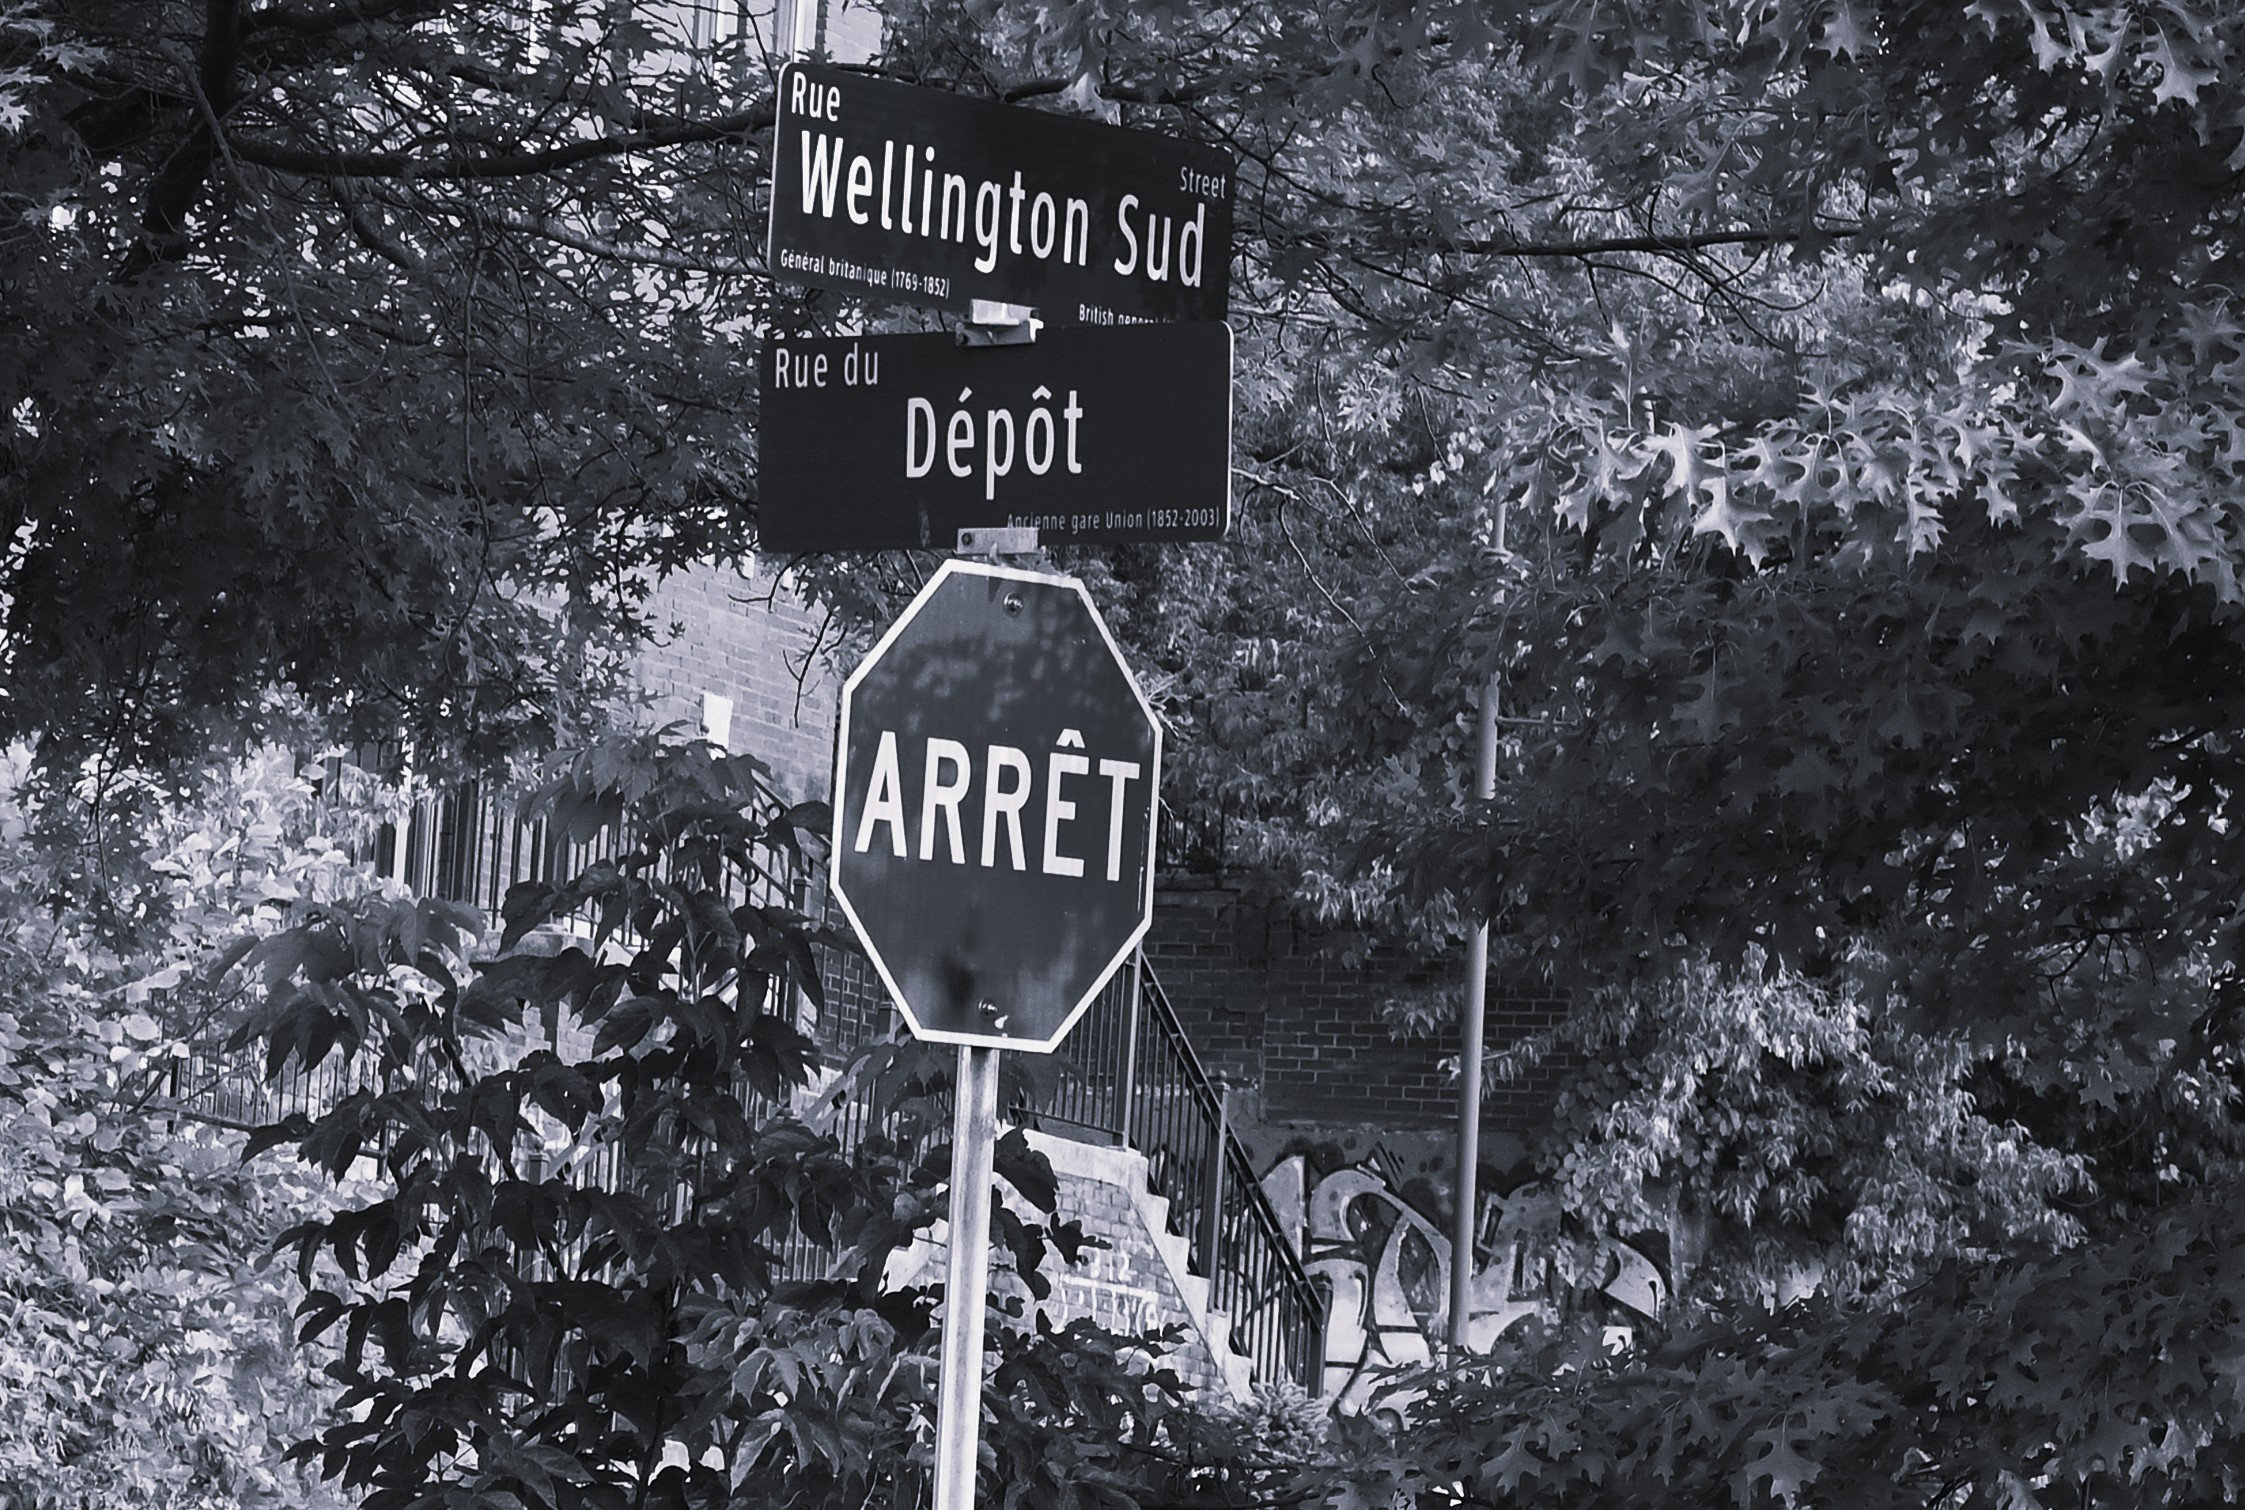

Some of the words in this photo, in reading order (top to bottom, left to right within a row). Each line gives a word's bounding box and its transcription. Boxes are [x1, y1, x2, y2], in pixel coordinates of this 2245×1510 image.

[791, 71, 841, 122] Rue
[1178, 166, 1227, 200] Street
[800, 130, 1089, 274] Wellington
[1113, 194, 1206, 288] Sud
[780, 248, 825, 274] Général
[829, 257, 888, 287] britanique
[891, 268, 950, 299] (1769-1852)
[1078, 303, 1114, 326] British
[774, 347, 828, 388] Rue
[844, 343, 879, 386] du
[905, 385, 1083, 501] Dépôt
[1006, 511, 1066, 531] Ancienne
[1071, 513, 1100, 535] gare
[1106, 509, 1143, 529] Union
[1146, 506, 1220, 531] (1852-2003)
[854, 728, 1141, 882] ARRÊT
